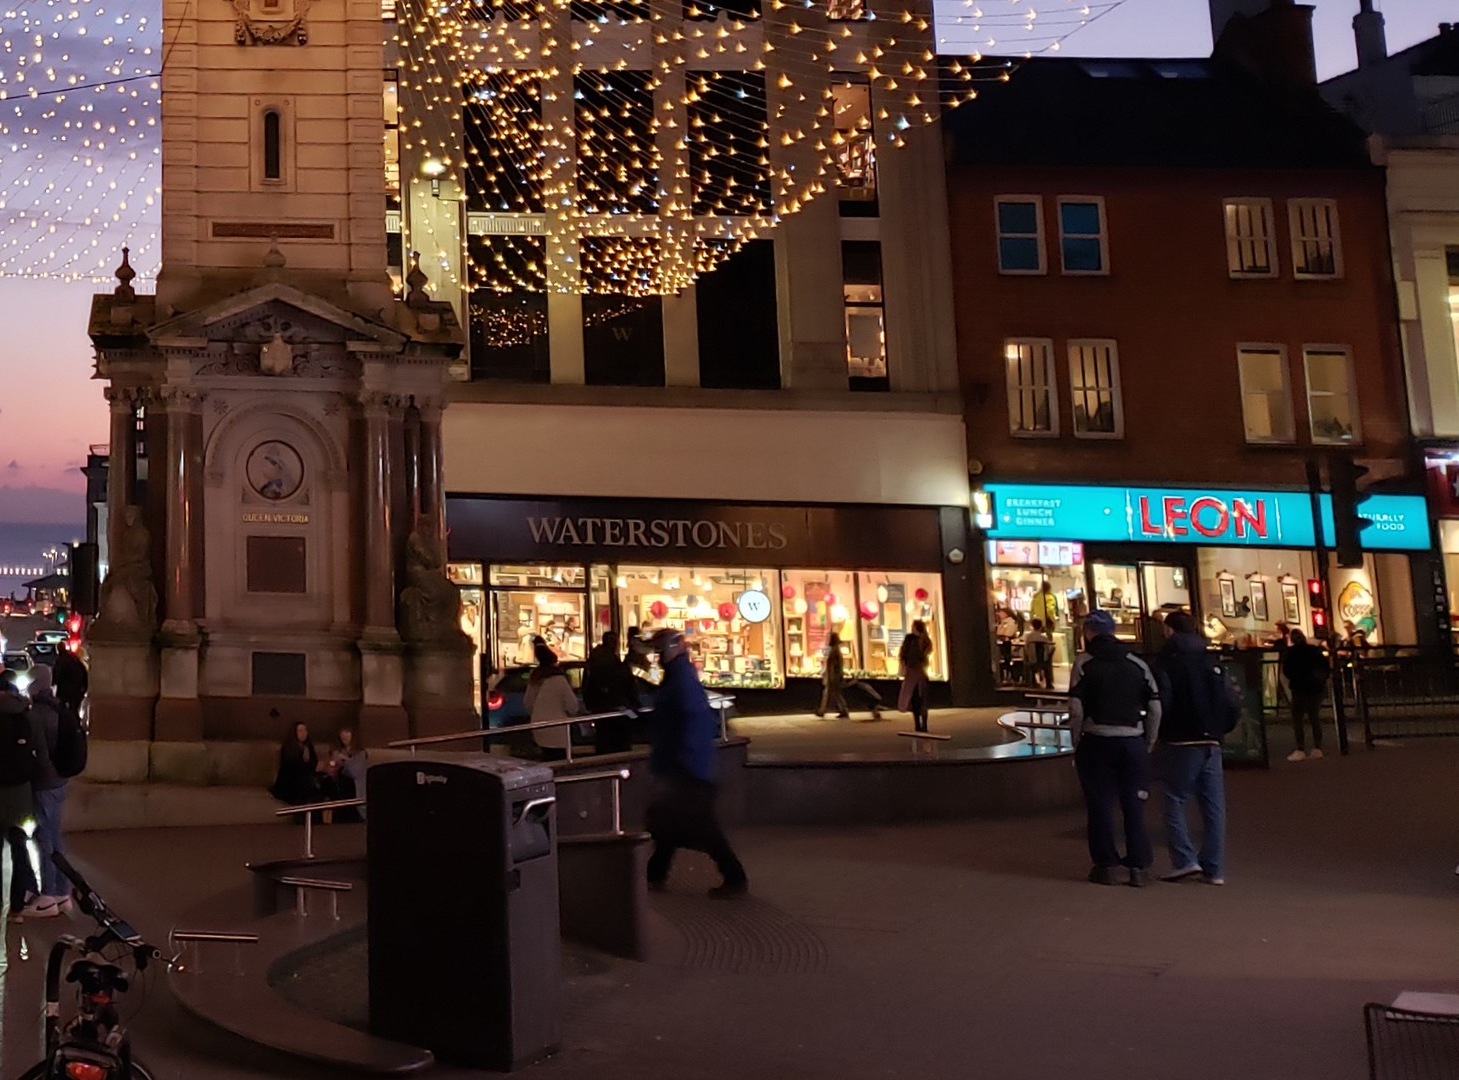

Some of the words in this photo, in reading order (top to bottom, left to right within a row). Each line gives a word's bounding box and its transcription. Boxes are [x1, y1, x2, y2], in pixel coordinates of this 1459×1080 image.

[1005, 498, 1061, 508] BREAKFAST
[1016, 508, 1053, 517] LUNCH
[1139, 495, 1268, 538] LEON
[242, 513, 270, 522] QUEEN
[273, 514, 309, 523] VICTORIA
[1016, 517, 1056, 526] DINNER
[527, 517, 788, 550] WATERSTONES
[748, 601, 761, 611] W
